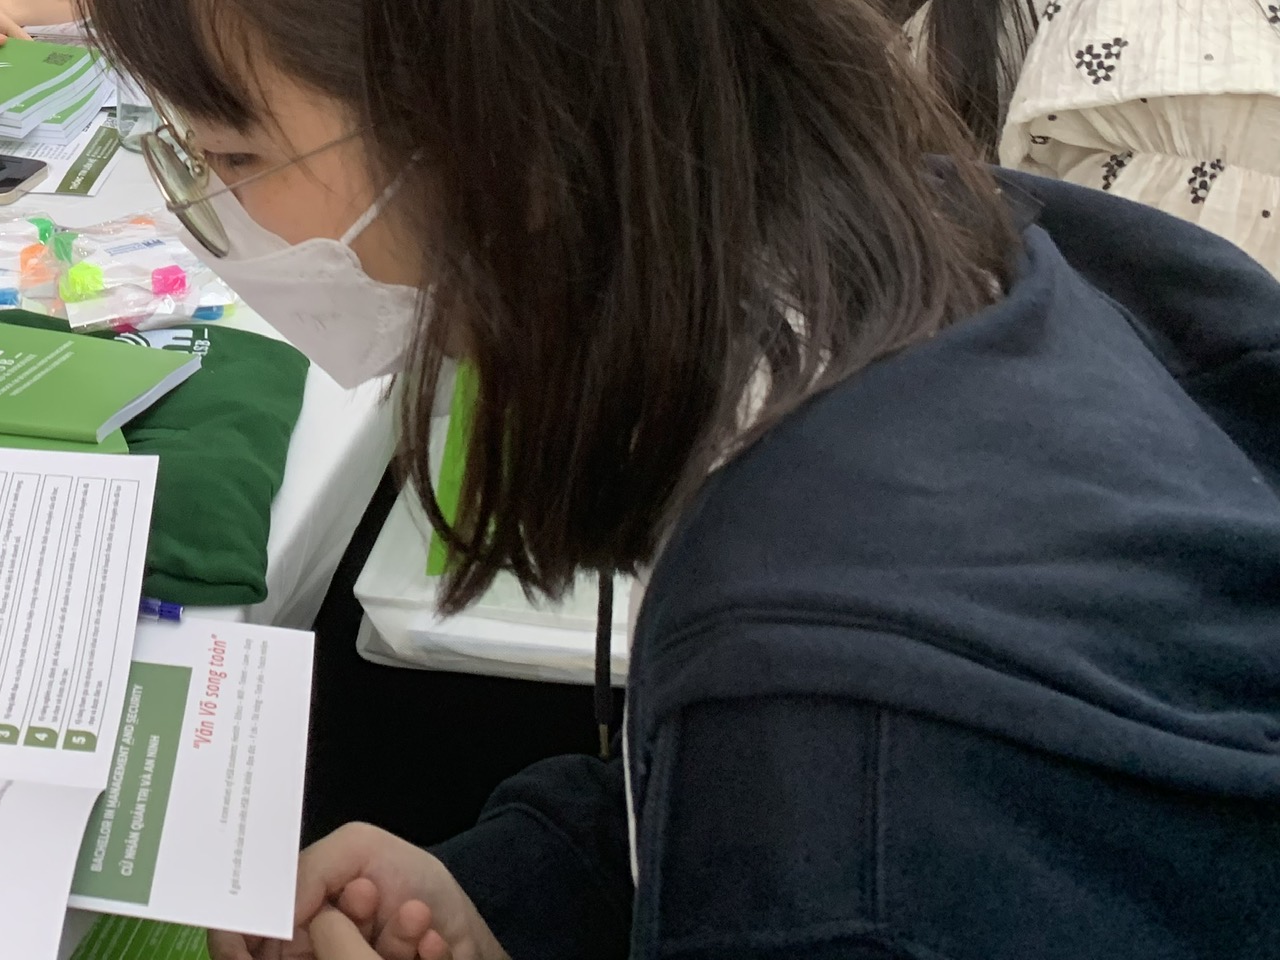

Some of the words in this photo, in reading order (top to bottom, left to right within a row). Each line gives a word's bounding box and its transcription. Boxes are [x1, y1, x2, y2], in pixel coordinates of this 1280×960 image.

[206, 669, 227, 698] song
[126, 684, 143, 723] SECURITY
[199, 700, 217, 716] Võ
[34, 733, 48, 741] 4
[72, 736, 86, 744] 5
[122, 724, 134, 745] AND
[147, 735, 160, 757] NINH
[144, 757, 155, 774] AN
[107, 745, 130, 809] MANAGEMENT
[139, 774, 152, 788] VÀ
[137, 786, 152, 804] TRỊ
[104, 808, 115, 819] IN
[130, 805, 146, 831] QUẢN
[90, 818, 111, 872] BACHELOR
[124, 831, 140, 859] NHÂN
[119, 859, 133, 876] CỬ
